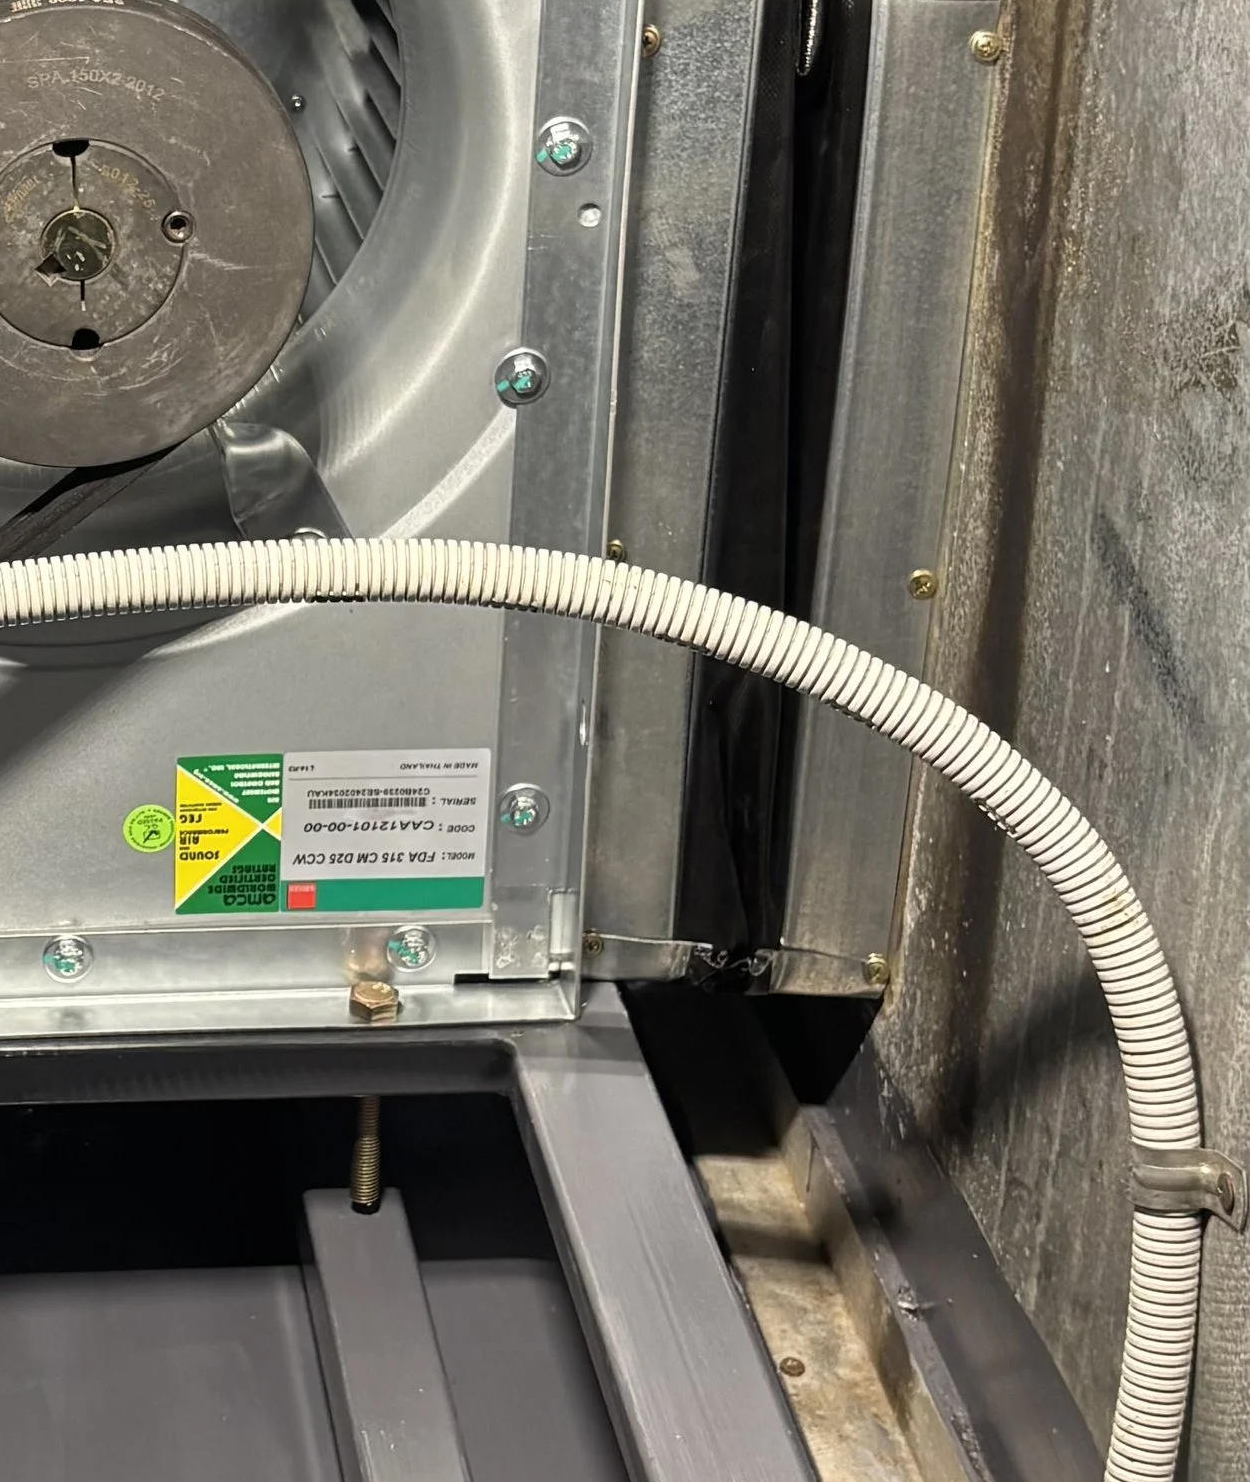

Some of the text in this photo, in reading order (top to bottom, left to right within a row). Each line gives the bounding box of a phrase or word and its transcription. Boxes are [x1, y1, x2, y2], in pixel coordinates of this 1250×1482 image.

[440, 797, 477, 805] SERIAL
[304, 820, 434, 833] CAA12101-00-00
[179, 836, 199, 845] AIR
[179, 850, 219, 860] SOUND
[293, 854, 326, 865] CCW
[330, 853, 353, 864] D25
[358, 853, 378, 864] CM
[382, 852, 404, 863] 315
[408, 851, 436, 863] FDA
[232, 864, 276, 874] RATINGS
[219, 874, 276, 883] CERTIFIED
[208, 884, 276, 893] WORLDWIDE
